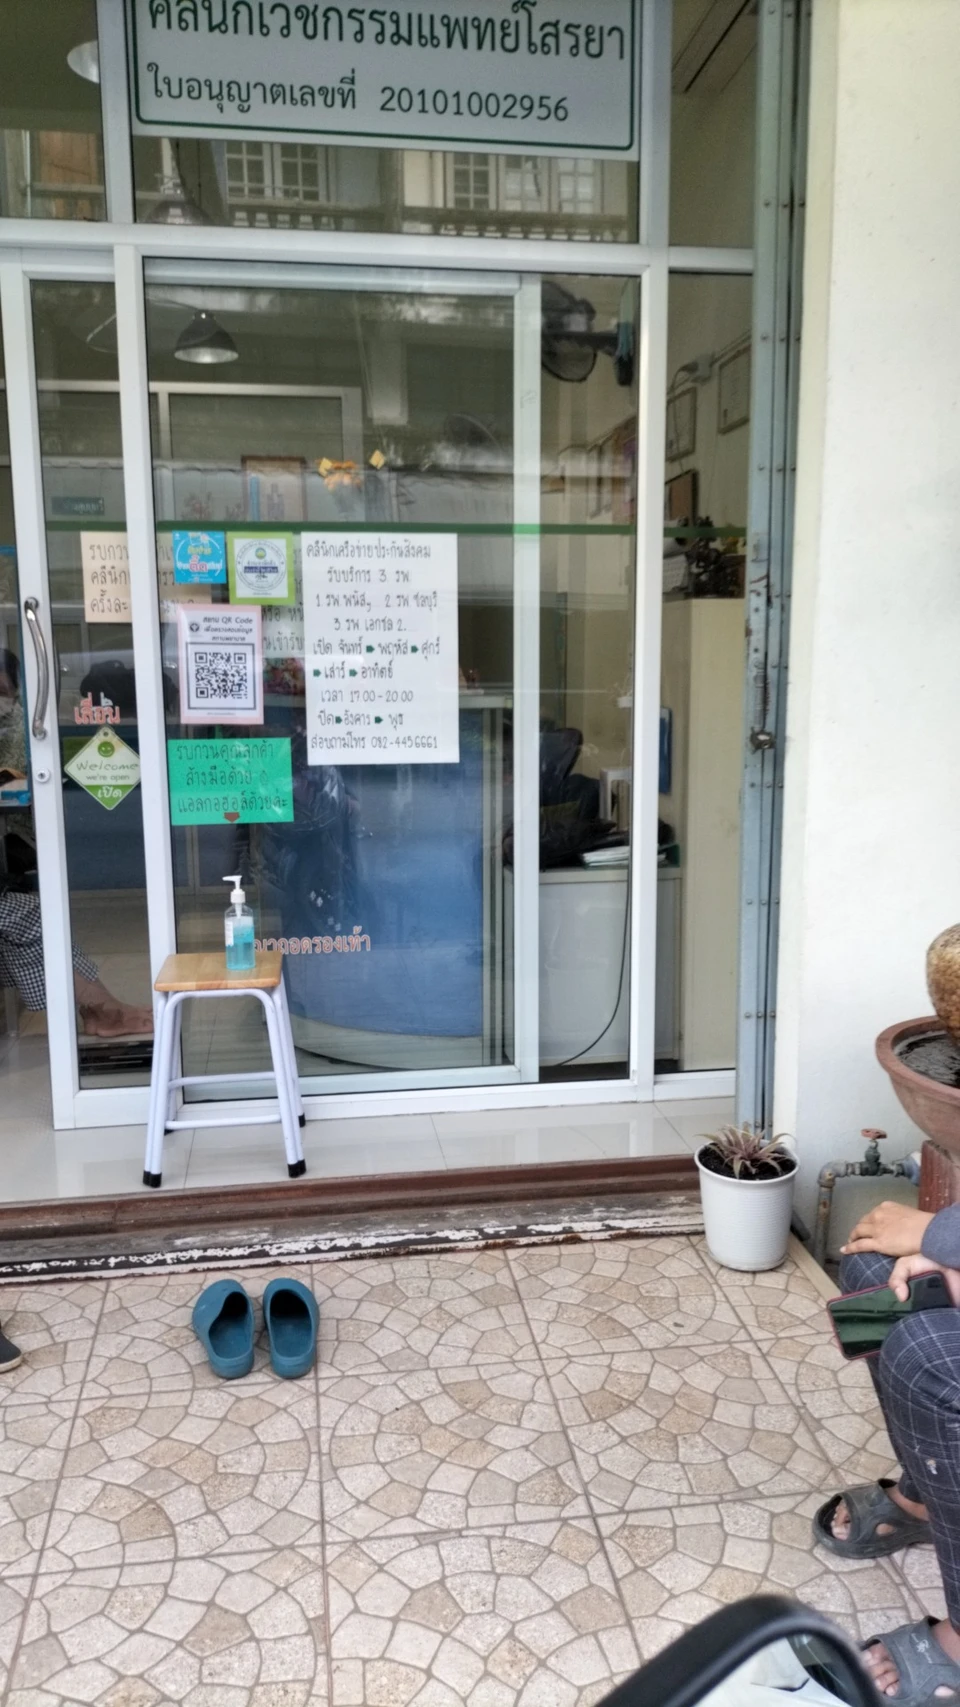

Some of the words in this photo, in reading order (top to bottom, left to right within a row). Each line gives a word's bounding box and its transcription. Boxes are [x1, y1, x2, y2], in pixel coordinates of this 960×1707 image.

[146, 63, 357, 113] ใบอนุญาตเลขที่
[379, 86, 569, 122] 20101002956
[379, 568, 387, 583] 3
[221, 616, 233, 625] QR
[235, 616, 253, 625] Code
[313, 637, 333, 656] เปิด
[338, 636, 364, 656] จันทร์
[320, 690, 344, 703] เวลา
[317, 709, 335, 726] ปิด
[76, 760, 140, 772] Welcome
[85, 773, 108, 781] we're
[110, 774, 131, 783] open
[97, 786, 123, 799] เปิด
